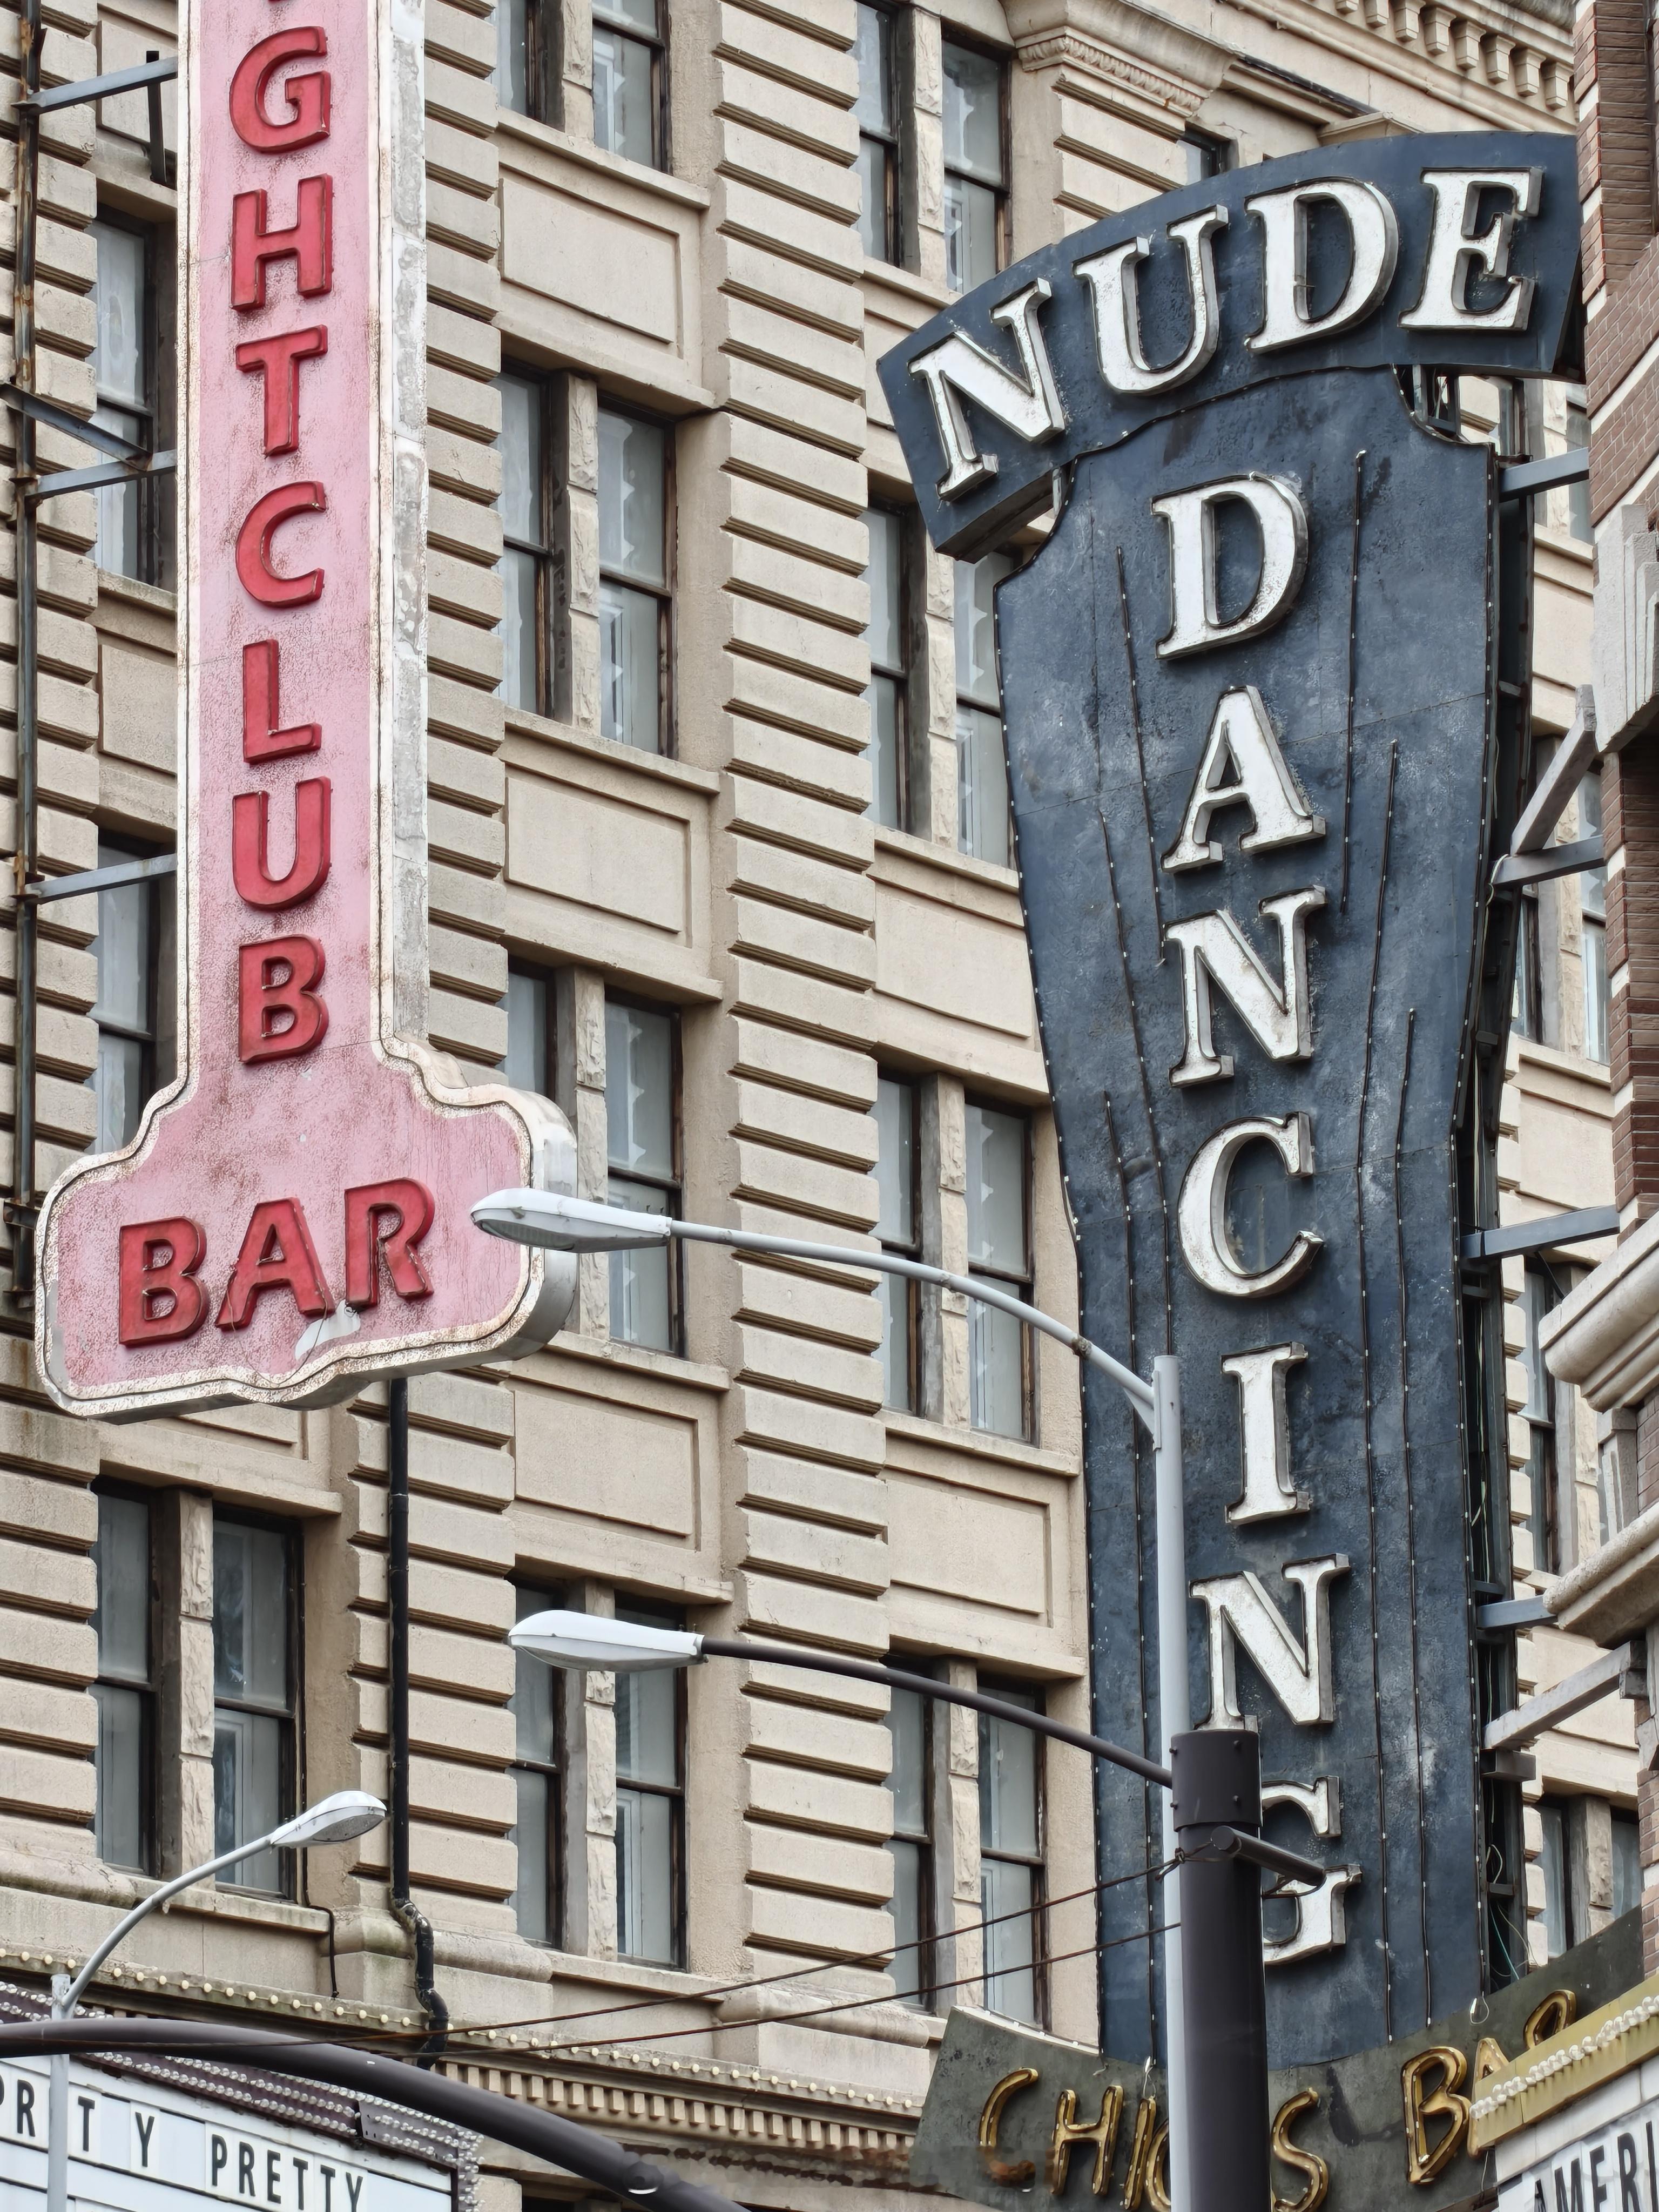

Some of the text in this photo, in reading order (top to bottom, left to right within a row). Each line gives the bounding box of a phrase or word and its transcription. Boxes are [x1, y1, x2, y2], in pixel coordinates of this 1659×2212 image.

[907, 166, 1545, 502] NUDE
[228, 0, 333, 1064] GHTCLUB
[118, 1177, 435, 1347] BAR
[1151, 471, 1363, 1966] DANCING
[212, 2134, 363, 2212] PRETTY
[978, 2067, 1330, 2212] CHIS
